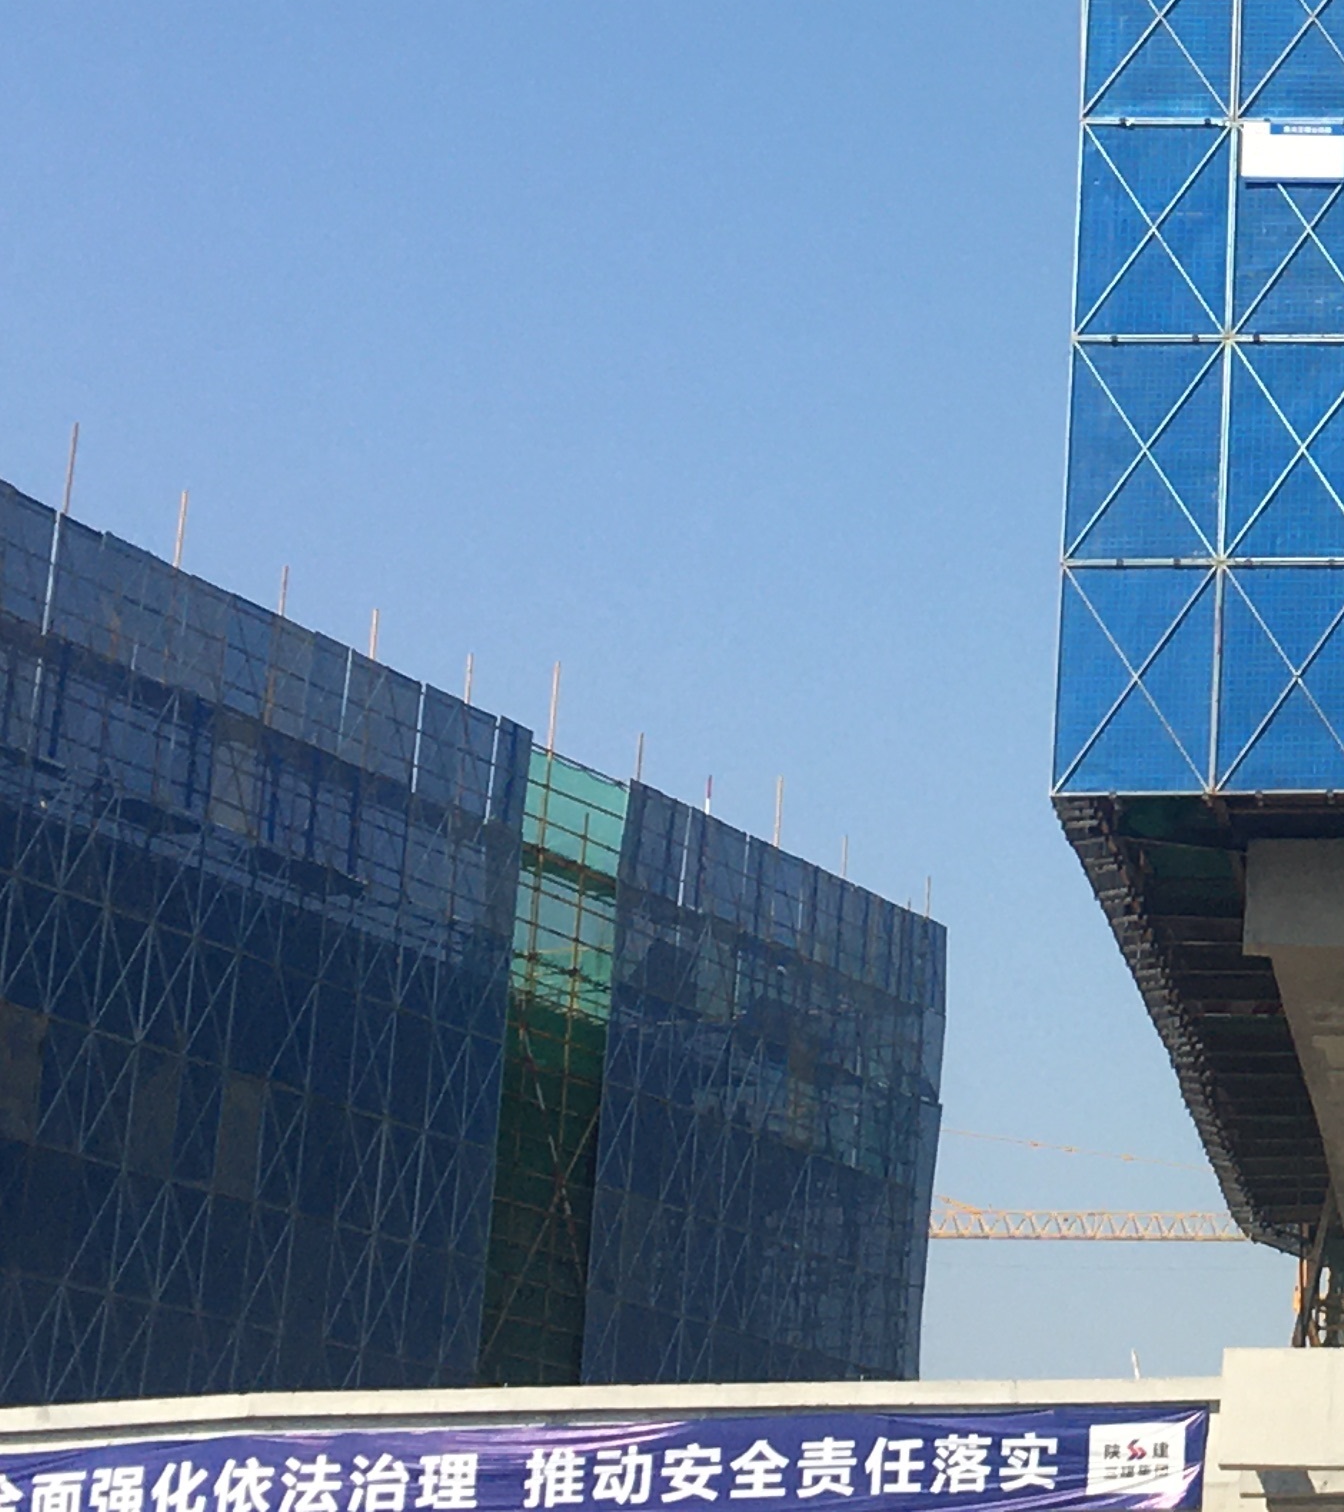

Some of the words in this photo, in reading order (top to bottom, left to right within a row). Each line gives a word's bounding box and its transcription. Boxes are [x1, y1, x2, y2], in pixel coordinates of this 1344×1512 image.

[523, 1432, 1059, 1510] 推动安全责任落实
